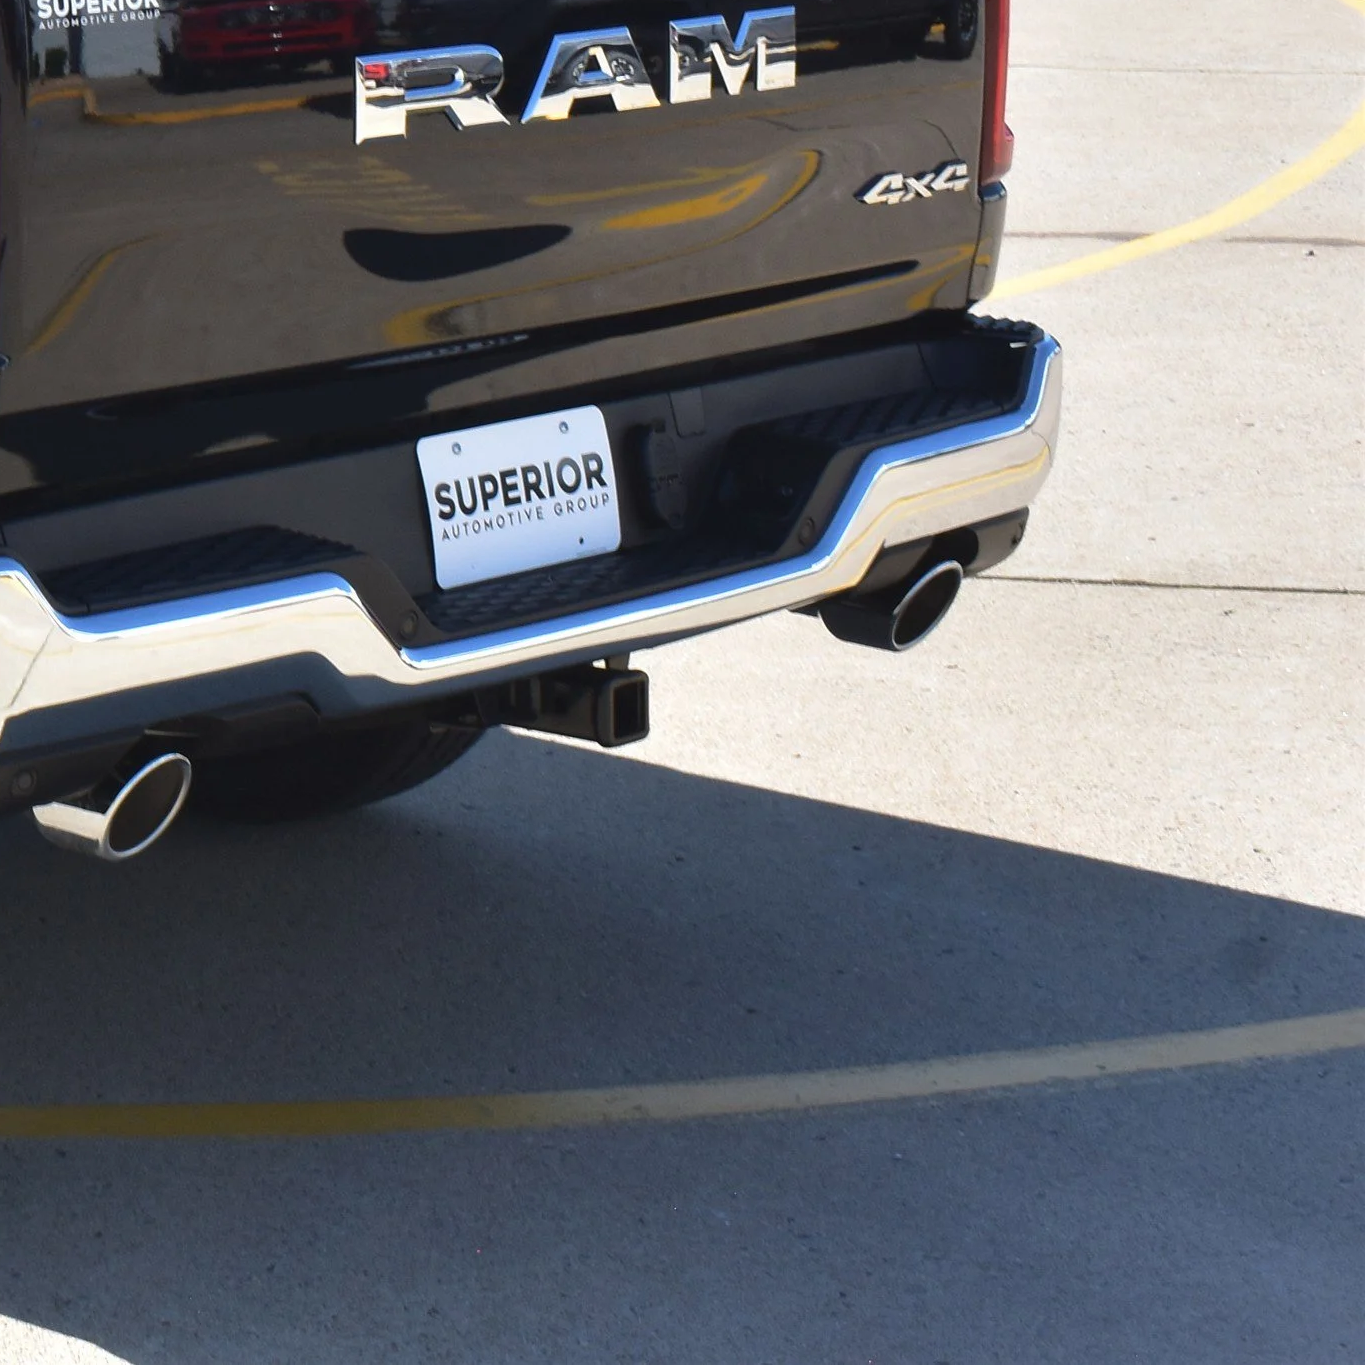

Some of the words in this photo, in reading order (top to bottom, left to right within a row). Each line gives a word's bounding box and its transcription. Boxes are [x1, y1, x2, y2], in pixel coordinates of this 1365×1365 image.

[38, 12, 116, 31] AUTOMOTIVE
[121, 8, 161, 23] GROUP
[355, 5, 796, 146] RAM
[434, 451, 608, 521] SUPERIOR
[440, 505, 545, 542] AUTOMOTIVE
[552, 492, 611, 517] GROUP
